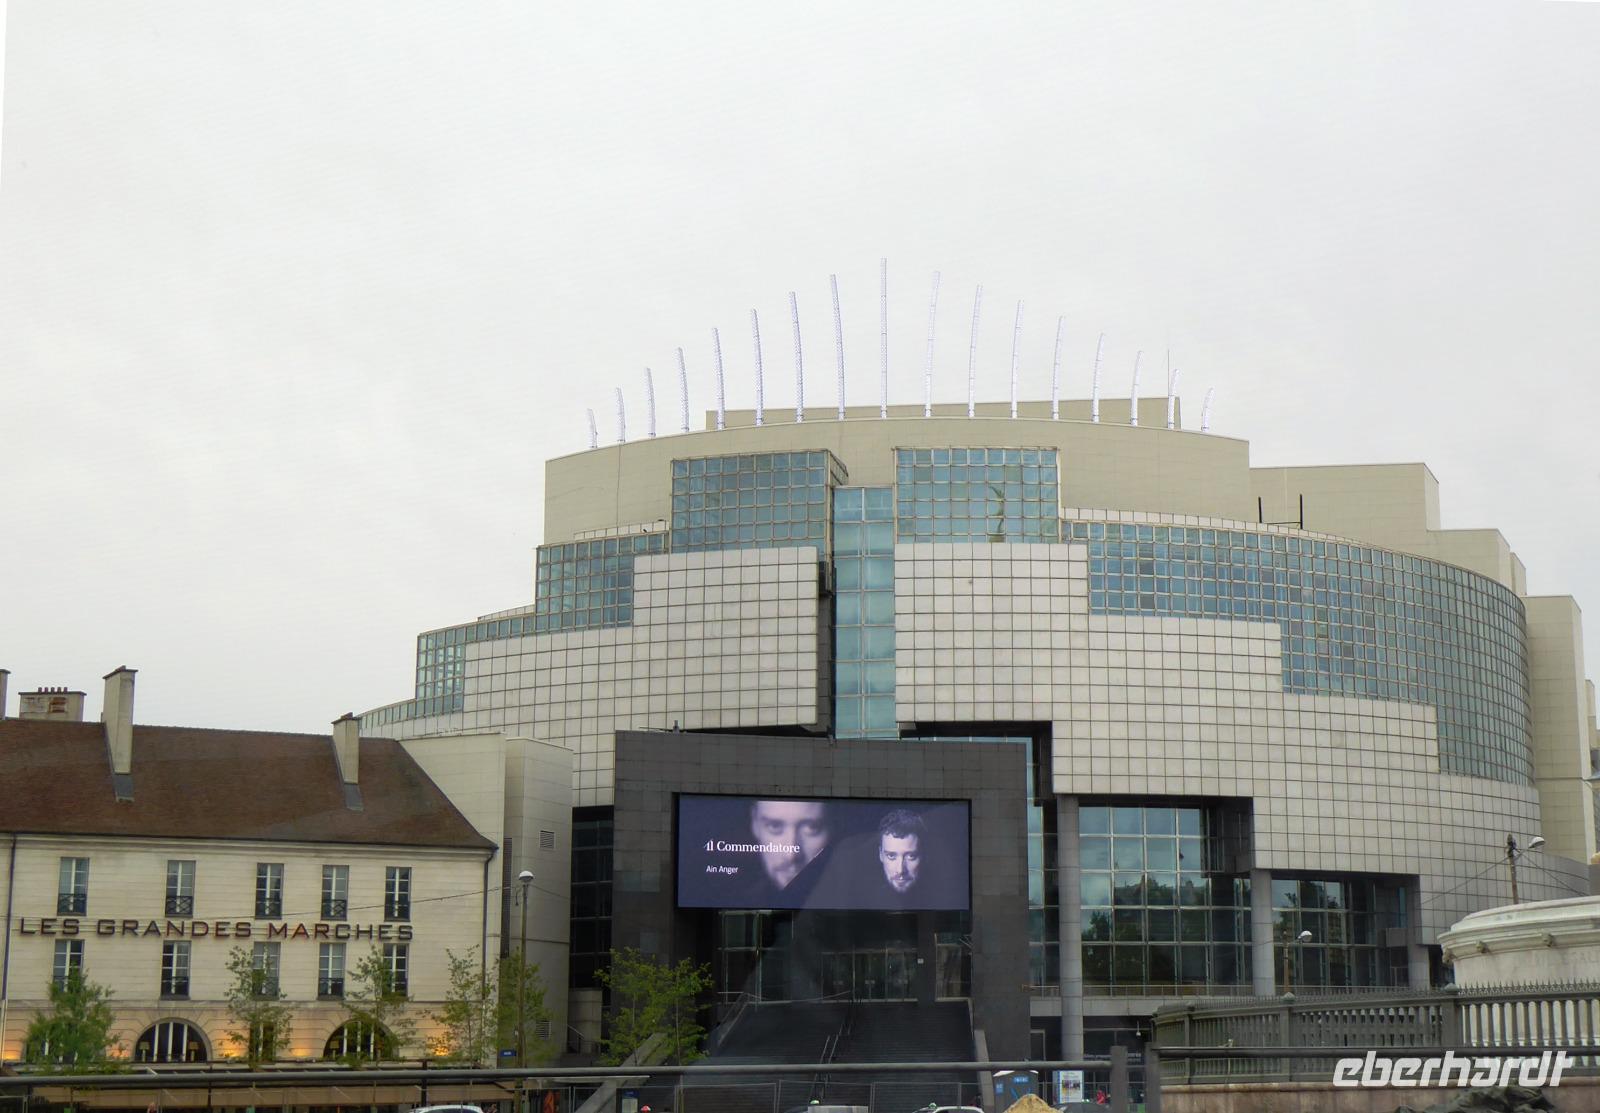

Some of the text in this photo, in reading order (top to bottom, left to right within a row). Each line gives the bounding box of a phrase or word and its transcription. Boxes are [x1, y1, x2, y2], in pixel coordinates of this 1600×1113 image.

[716, 840, 800, 853] Commendatore
[706, 865, 738, 875] Ain Anger
[20, 917, 414, 941] LES GRANDES MARCHES
